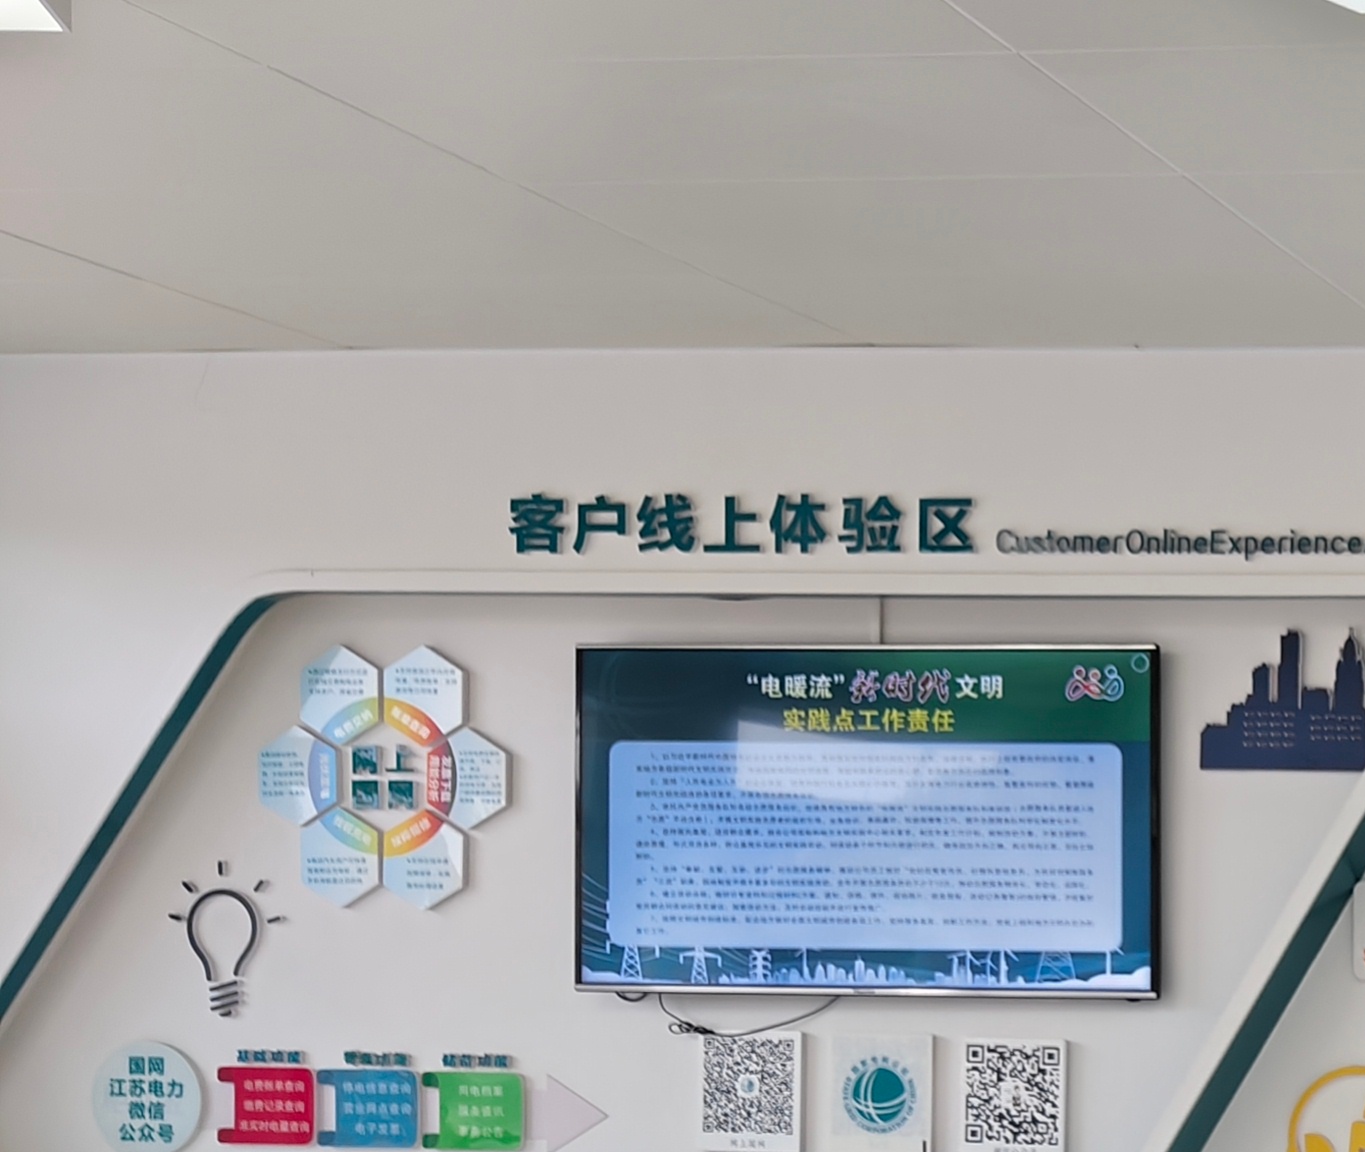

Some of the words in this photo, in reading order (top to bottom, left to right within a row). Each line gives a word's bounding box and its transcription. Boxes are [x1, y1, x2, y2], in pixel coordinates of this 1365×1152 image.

[508, 493, 977, 554] 客户线上体验区
[783, 708, 955, 733] 实践点工作责任
[128, 1055, 165, 1076] 国网
[109, 1078, 184, 1098] 江苏电力
[128, 1101, 165, 1122] 微信
[119, 1124, 175, 1144] 公众号
